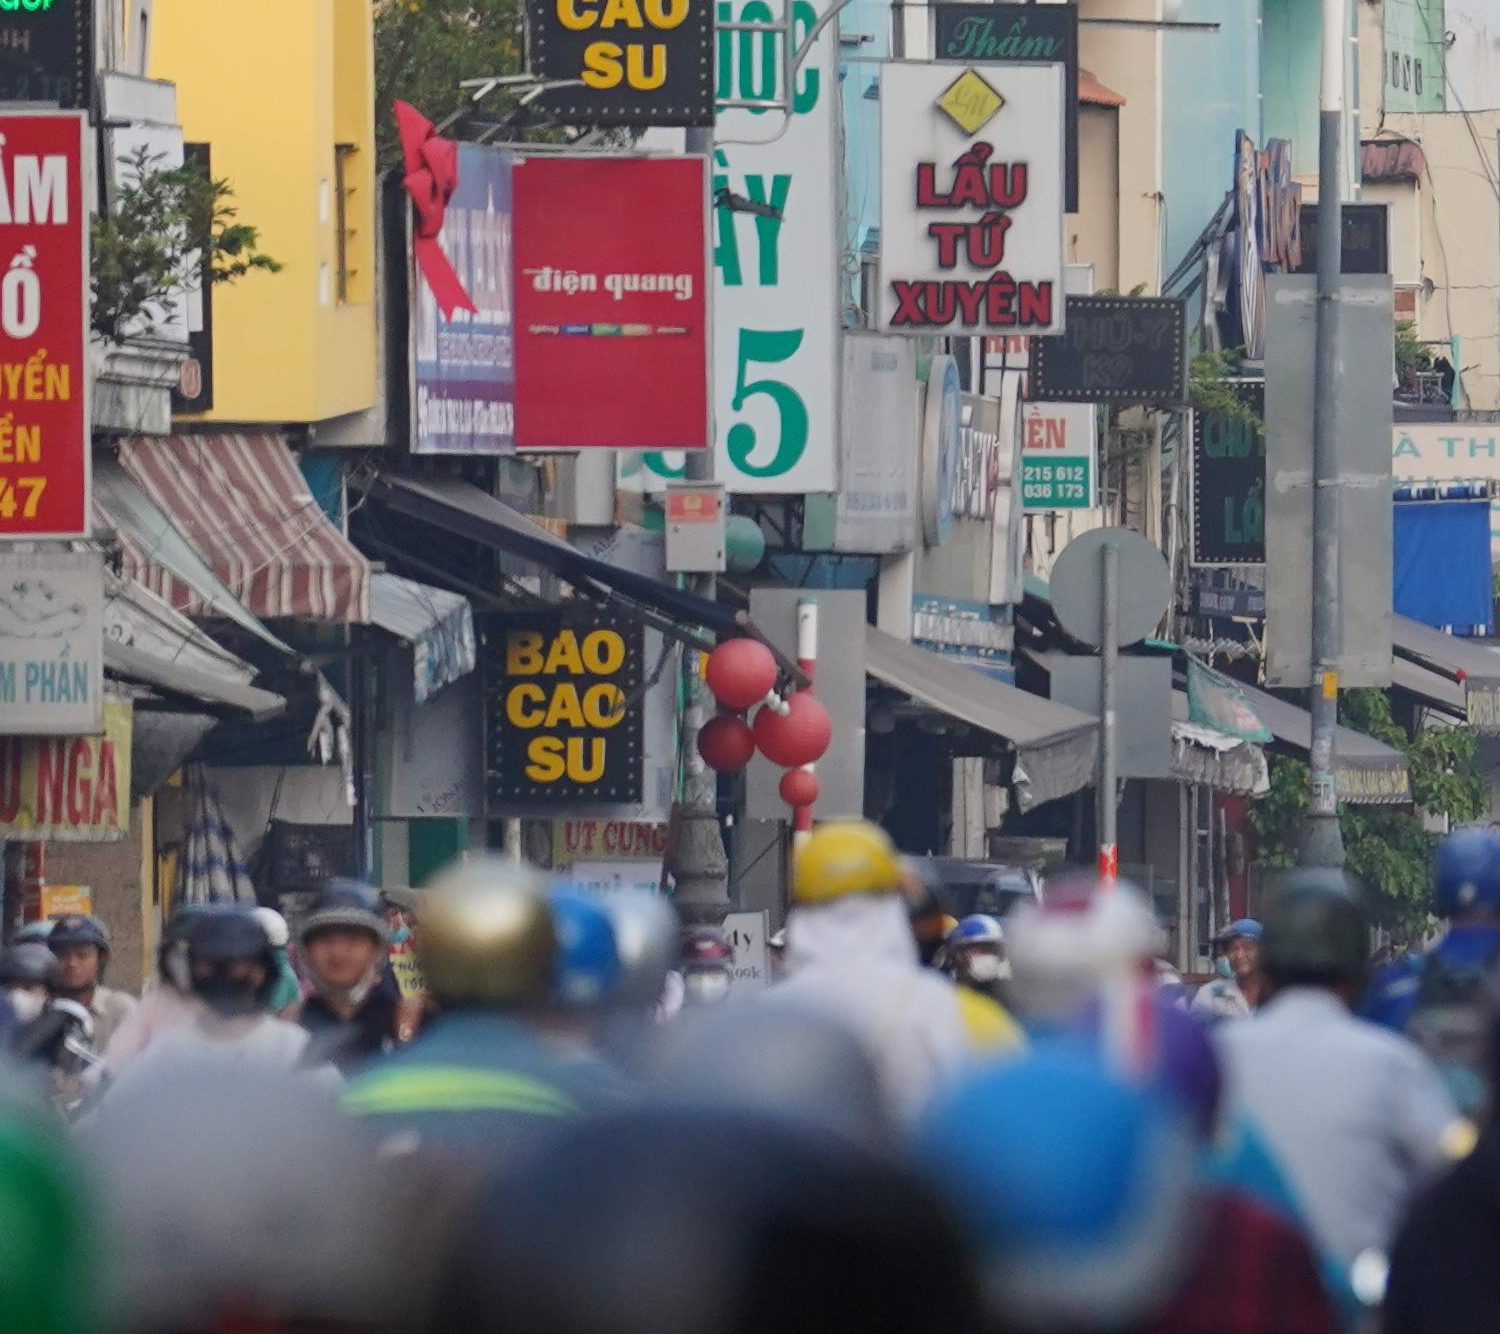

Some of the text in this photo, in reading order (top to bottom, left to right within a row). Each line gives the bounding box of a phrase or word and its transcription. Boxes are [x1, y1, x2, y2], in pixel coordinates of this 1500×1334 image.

[581, 43, 667, 89] SU
[917, 142, 1028, 208] LẨU
[929, 213, 1012, 268] TỨ
[523, 265, 693, 301] điện quang
[891, 271, 1051, 327] XUYÊN
[507, 629, 625, 675] BAO
[506, 682, 625, 728] CAO
[525, 736, 606, 783] SU
